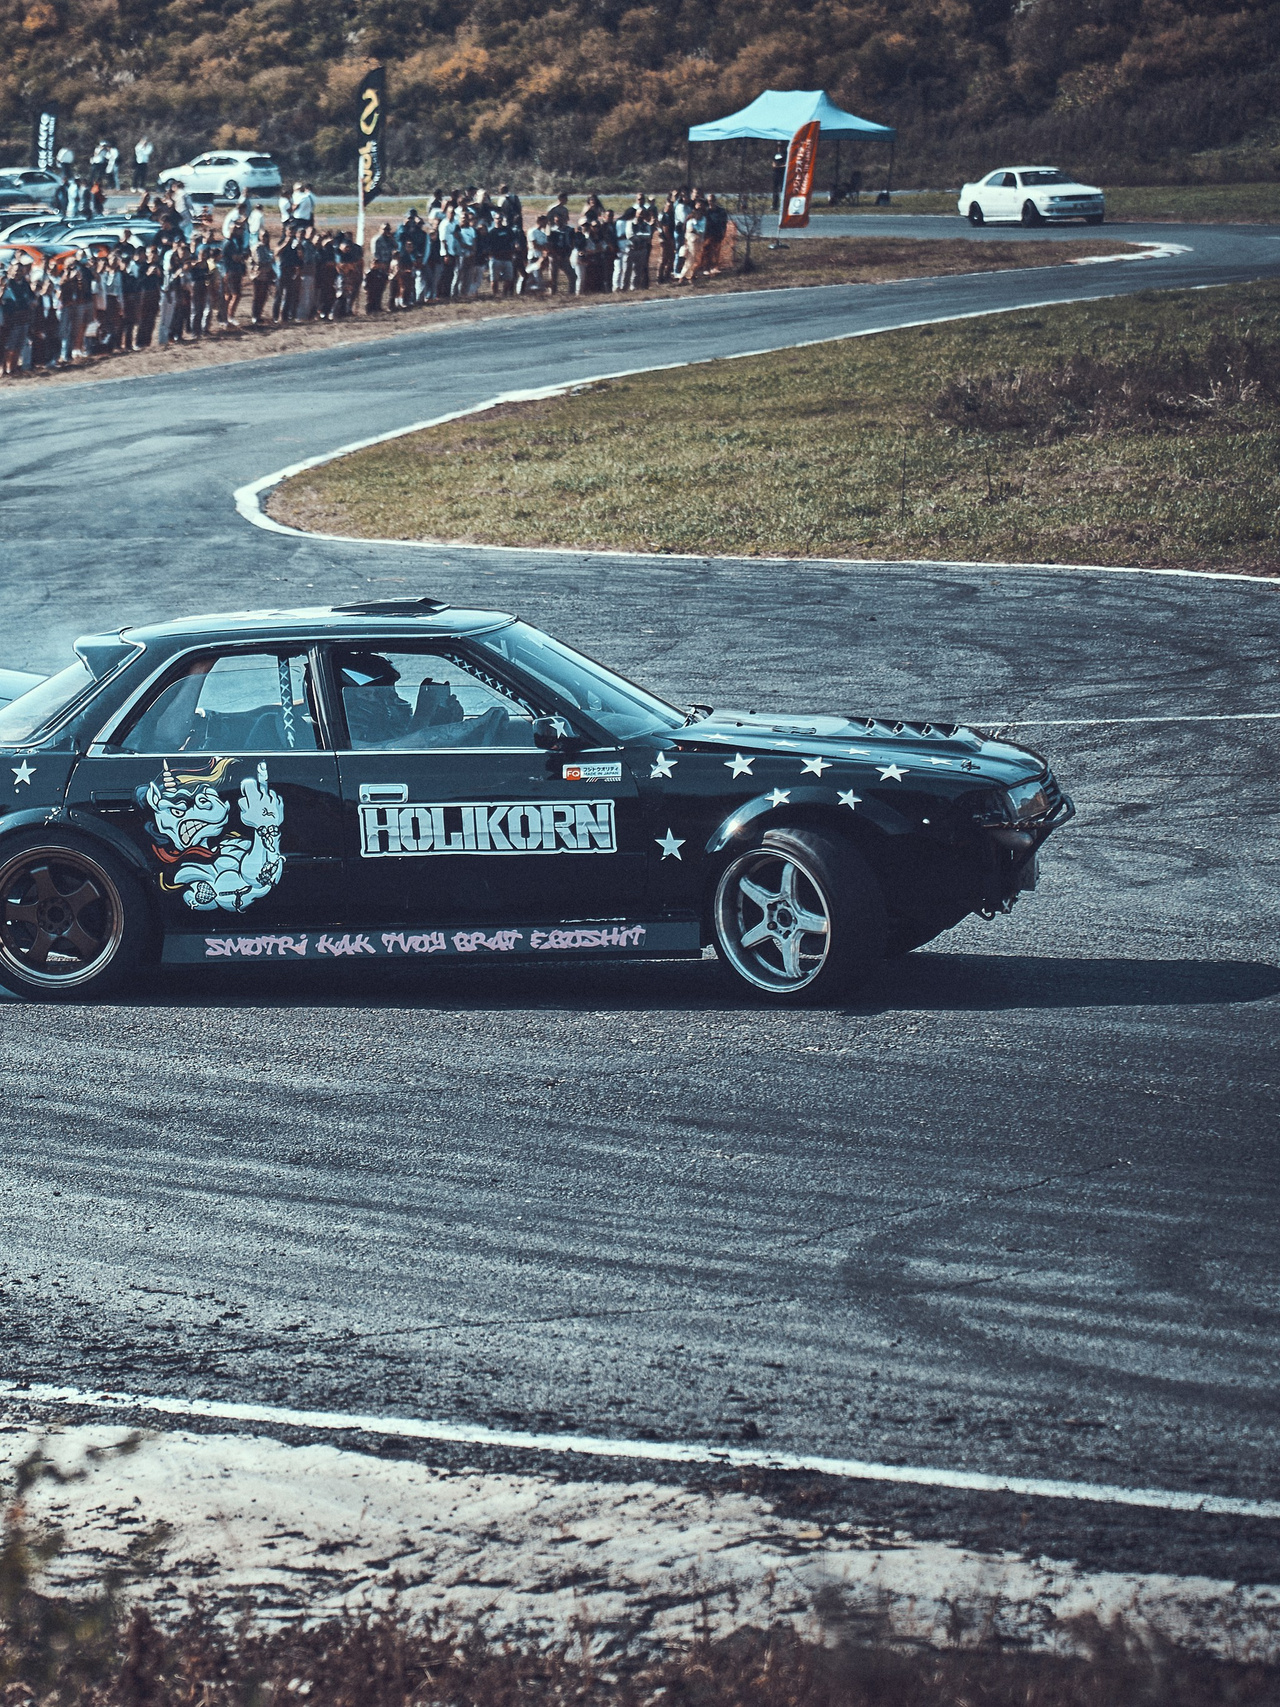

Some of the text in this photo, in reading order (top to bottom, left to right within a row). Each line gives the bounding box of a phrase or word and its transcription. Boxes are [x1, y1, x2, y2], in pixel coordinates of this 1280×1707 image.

[567, 770, 580, 778] FQ
[363, 804, 612, 852] HOLIKORN
[315, 934, 377, 957] KAK
[381, 932, 447, 954] TVOY
[451, 930, 523, 952] BRAT
